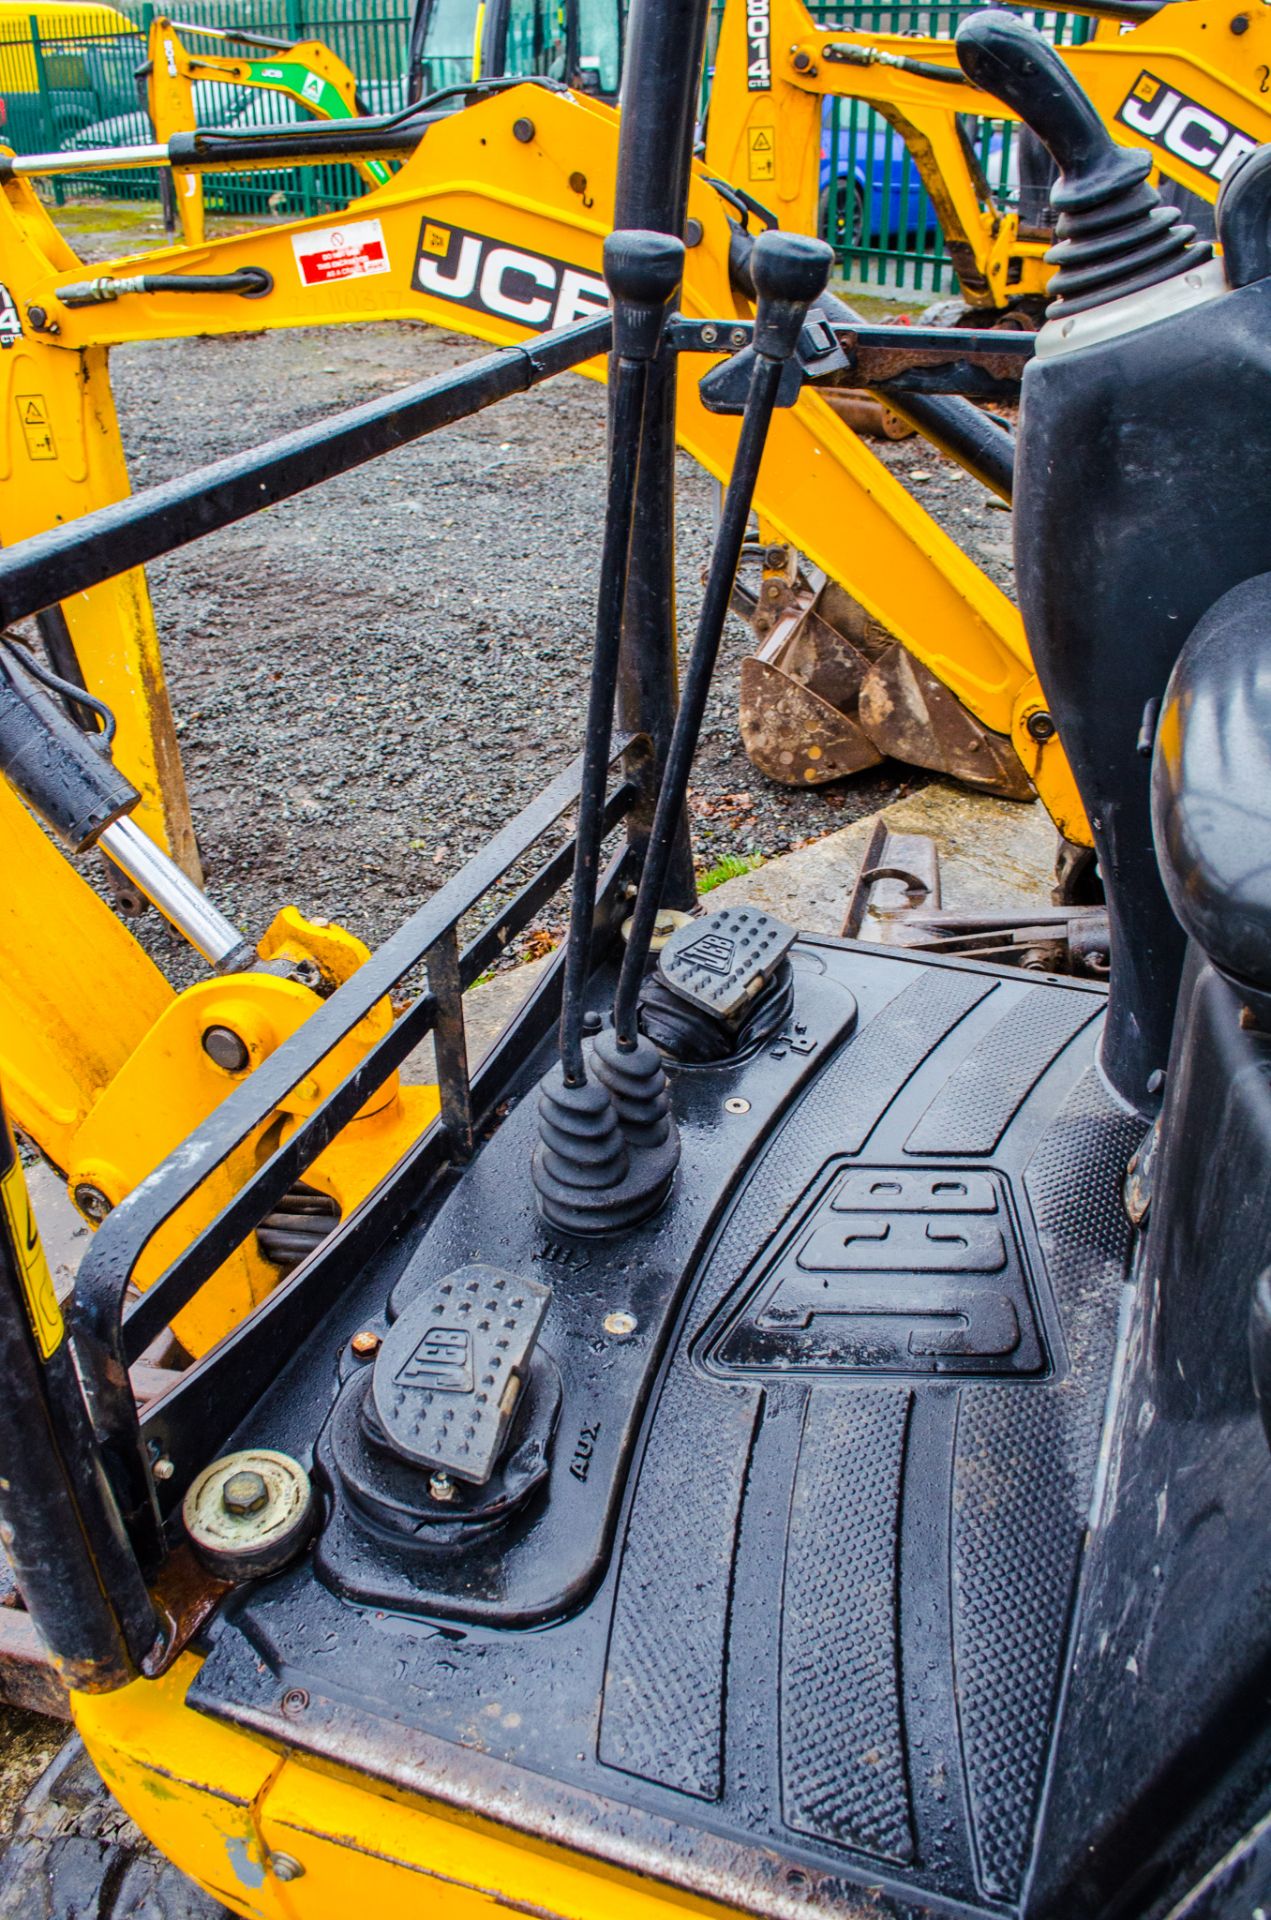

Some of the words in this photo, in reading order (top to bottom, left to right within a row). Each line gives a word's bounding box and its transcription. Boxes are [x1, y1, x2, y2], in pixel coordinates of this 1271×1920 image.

[747, 0, 770, 79] 8014
[681, 935, 734, 972] JCB
[752, 1170, 1021, 1356] JCB
[402, 1328, 470, 1389] JCB
[570, 1421, 601, 1483] AUX
